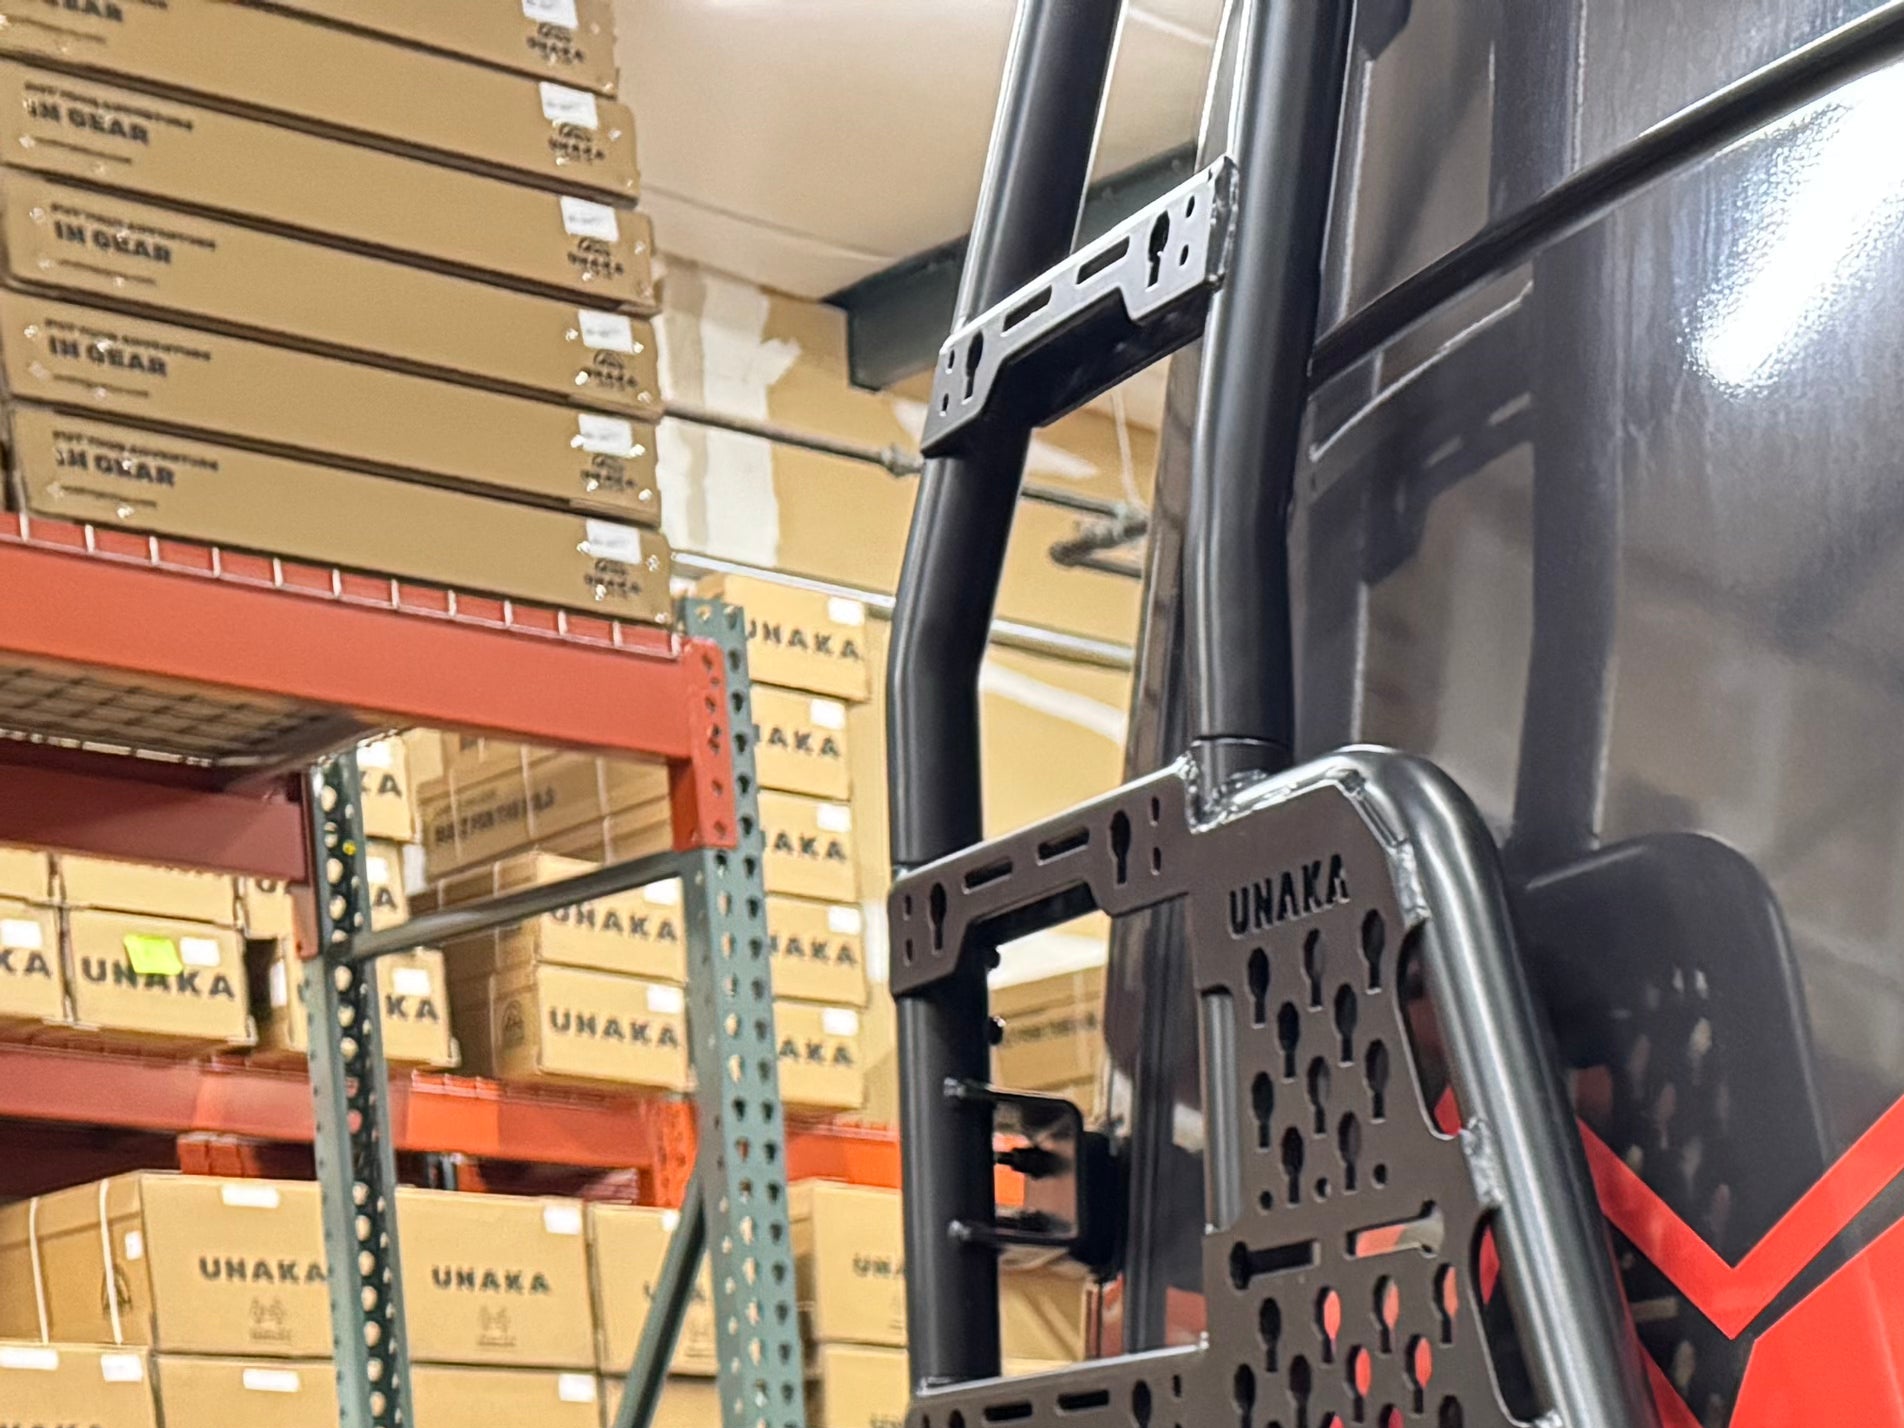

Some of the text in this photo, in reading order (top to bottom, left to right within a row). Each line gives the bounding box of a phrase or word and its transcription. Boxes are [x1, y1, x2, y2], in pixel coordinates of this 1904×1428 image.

[92, 229, 173, 265] GEAR
[86, 343, 168, 377] GEAR
[1228, 853, 1351, 938] UNAKA
[550, 1007, 679, 1049] UNAKA
[199, 1256, 330, 1285] UNAKA
[432, 1264, 553, 1296] UNAKA
